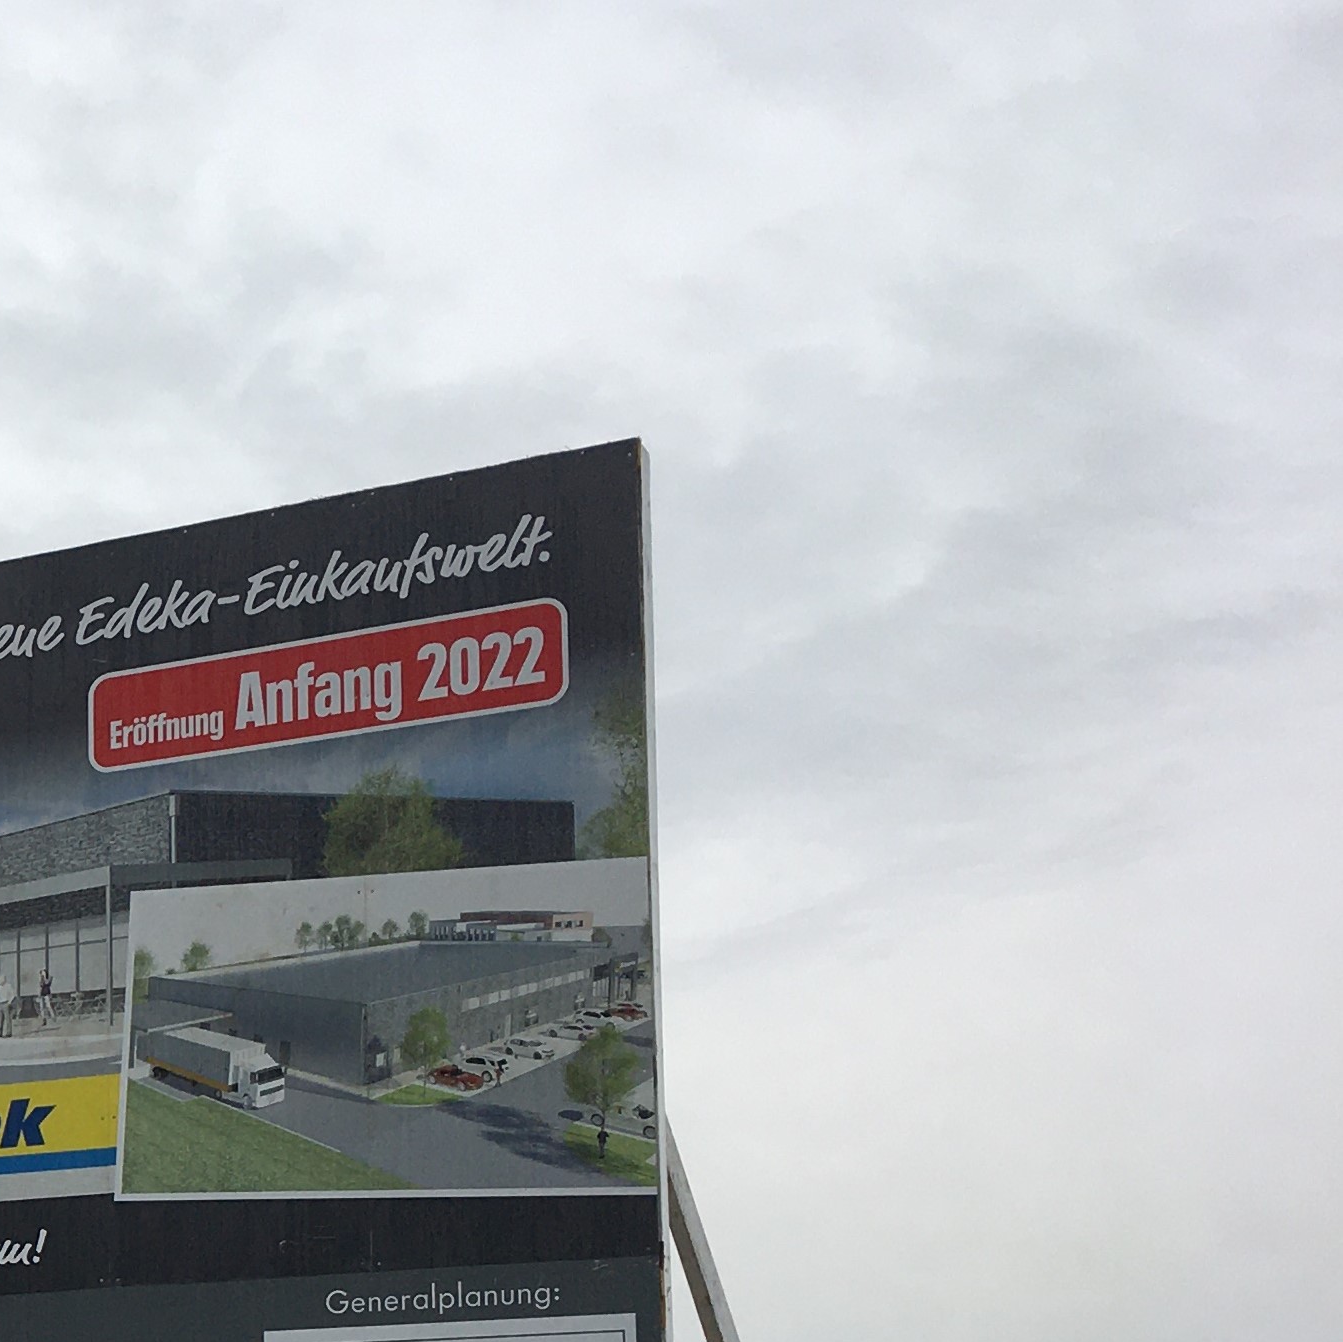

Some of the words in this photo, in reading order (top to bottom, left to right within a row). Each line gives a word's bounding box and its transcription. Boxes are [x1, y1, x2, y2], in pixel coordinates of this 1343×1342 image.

[75, 514, 553, 646] Edeka-Einkaufswelt.
[109, 708, 223, 750] Eröffnung
[235, 660, 402, 730] Anfang
[416, 626, 545, 701] 2022
[326, 1285, 560, 1315] Generalplanung:
